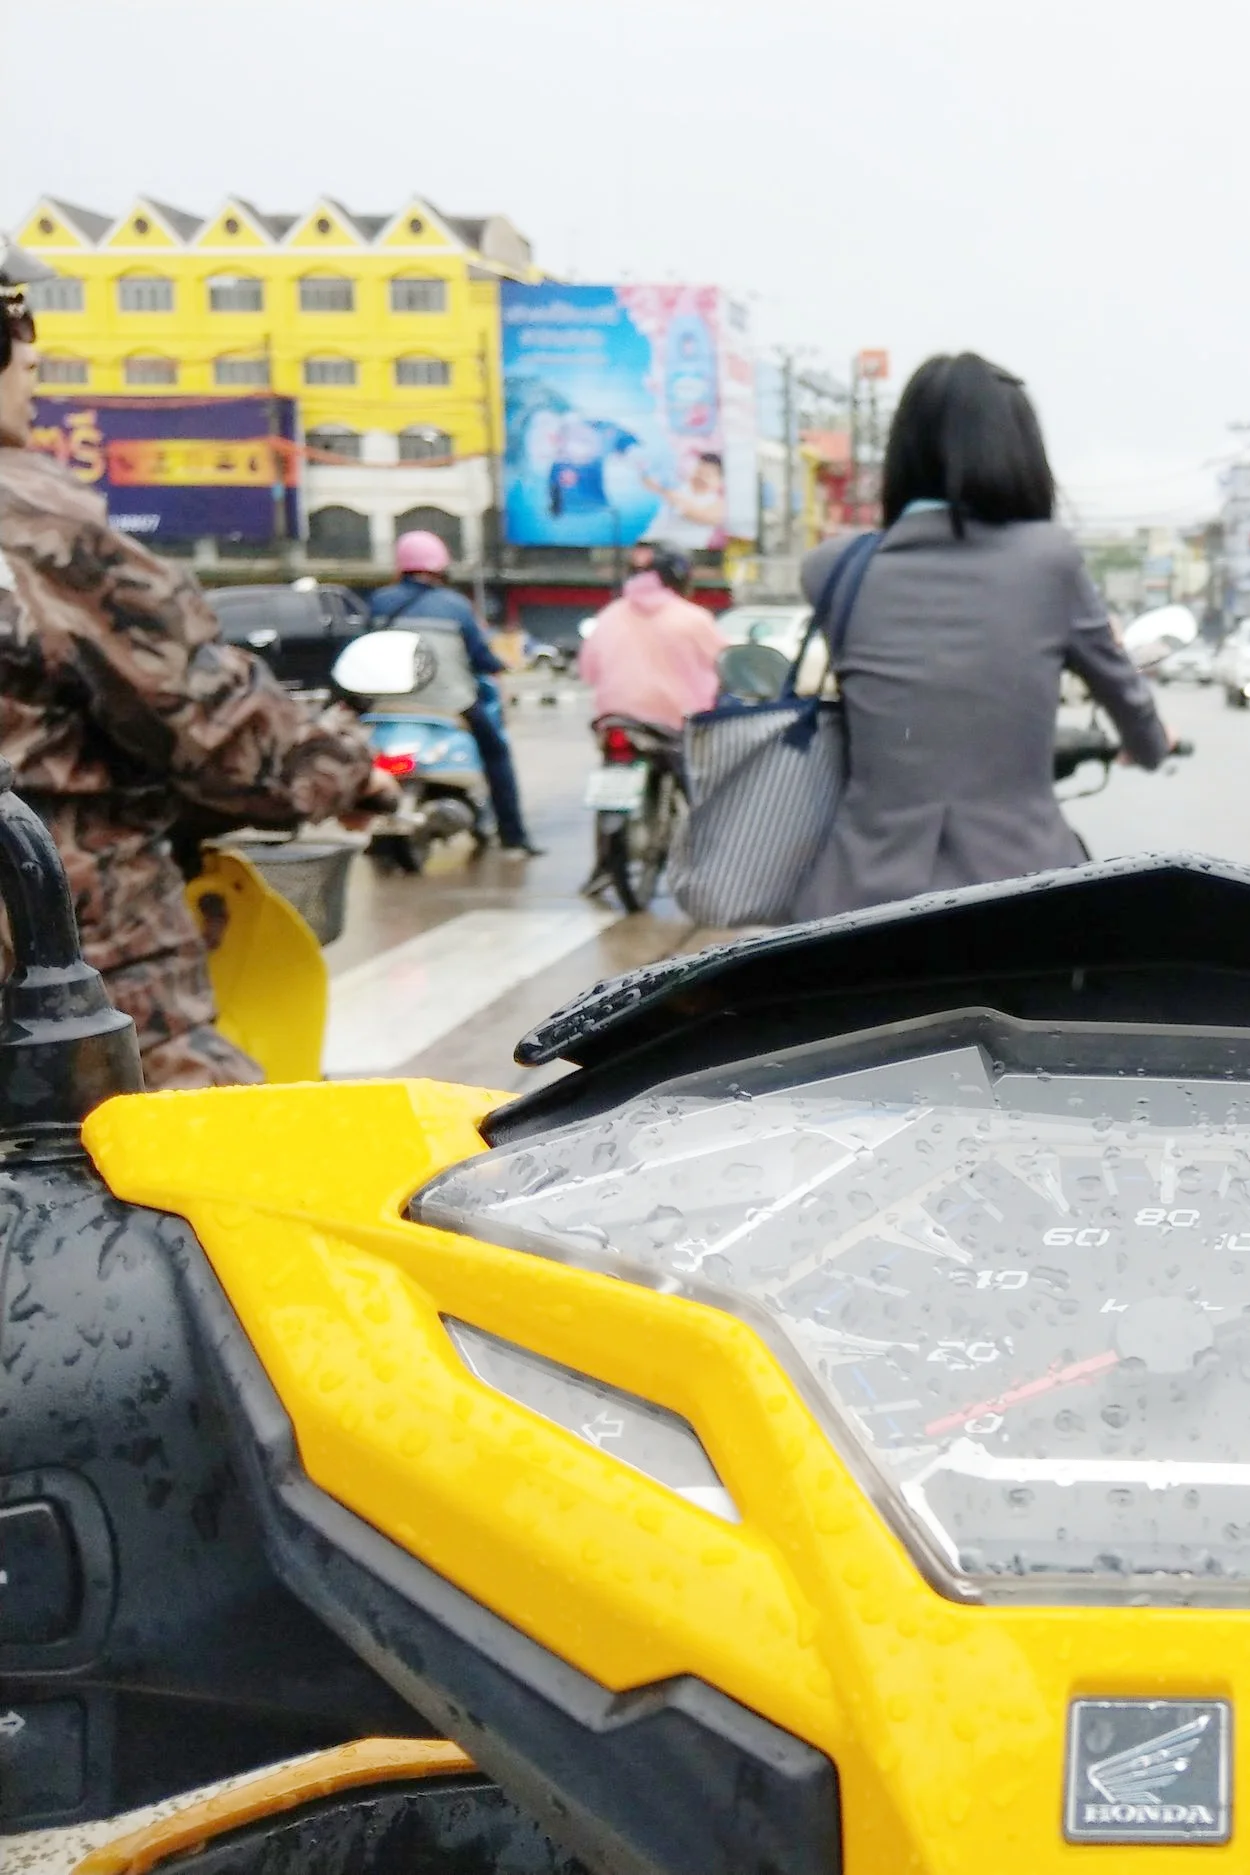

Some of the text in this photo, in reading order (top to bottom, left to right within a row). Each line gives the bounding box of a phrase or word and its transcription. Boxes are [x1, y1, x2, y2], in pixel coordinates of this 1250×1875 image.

[1134, 1208, 1200, 1227] 80
[1042, 1227, 1110, 1247] 60
[1084, 1803, 1215, 1825] HONDA
